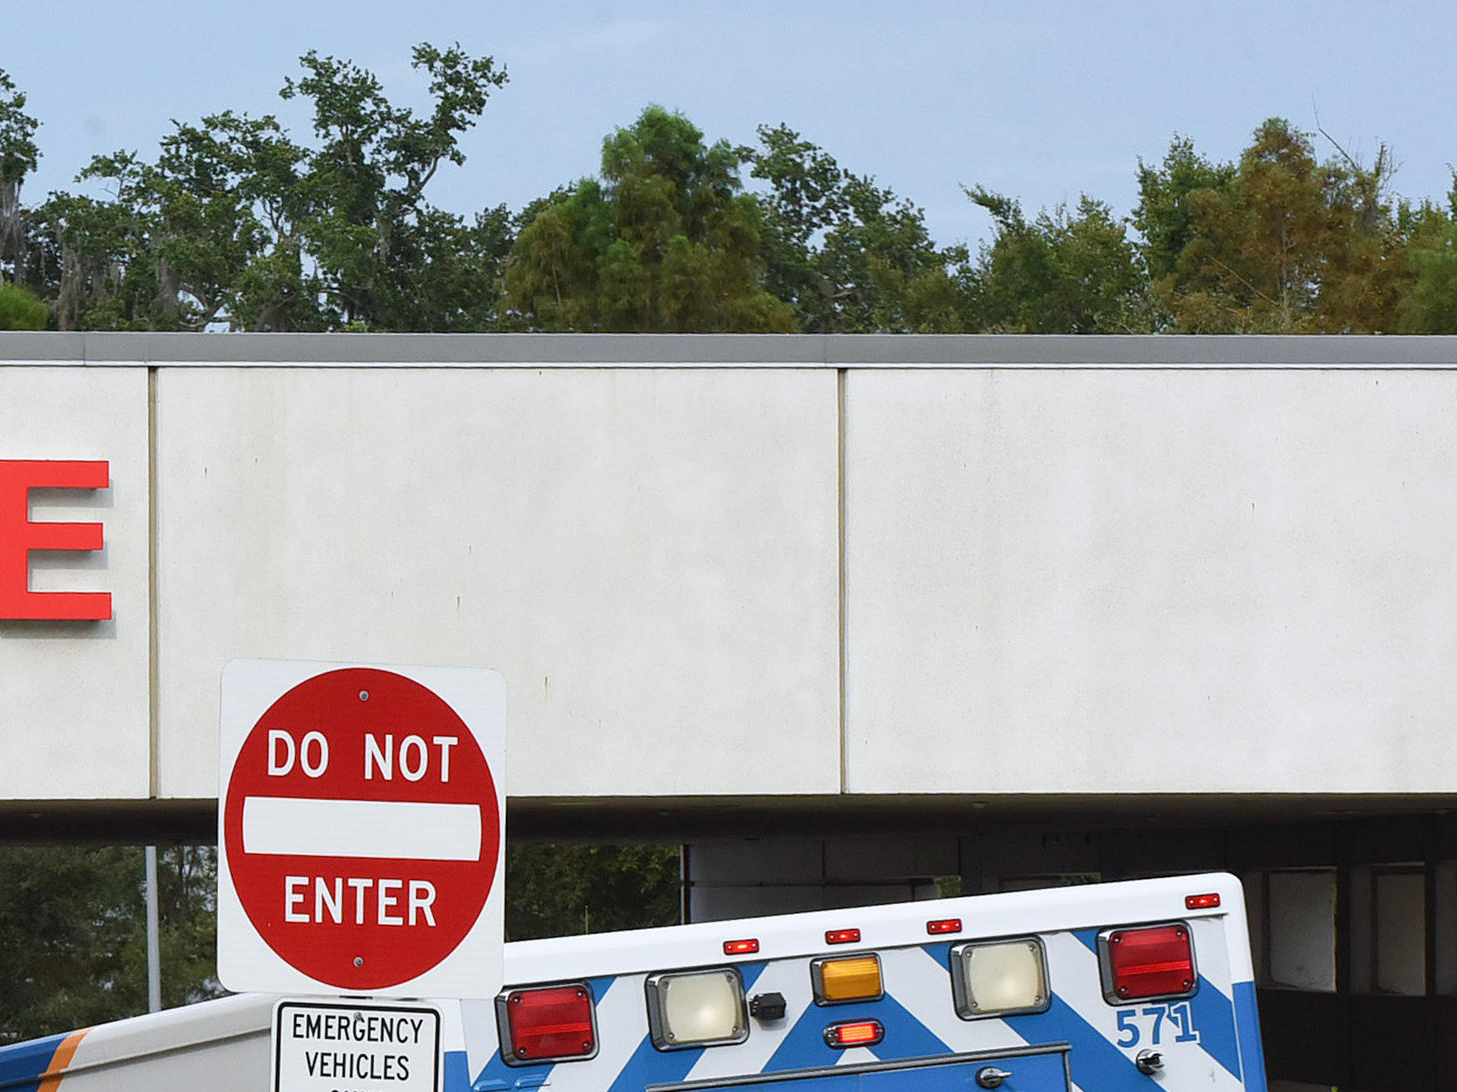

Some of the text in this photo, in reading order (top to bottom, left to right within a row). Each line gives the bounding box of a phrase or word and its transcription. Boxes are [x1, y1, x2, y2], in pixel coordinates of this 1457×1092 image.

[267, 729, 458, 783] DO NOT
[285, 876, 436, 927] ENTER
[293, 1013, 423, 1044] EMERGENCY
[1116, 1002, 1198, 1049] 571
[305, 1052, 410, 1081] VEHICLES
